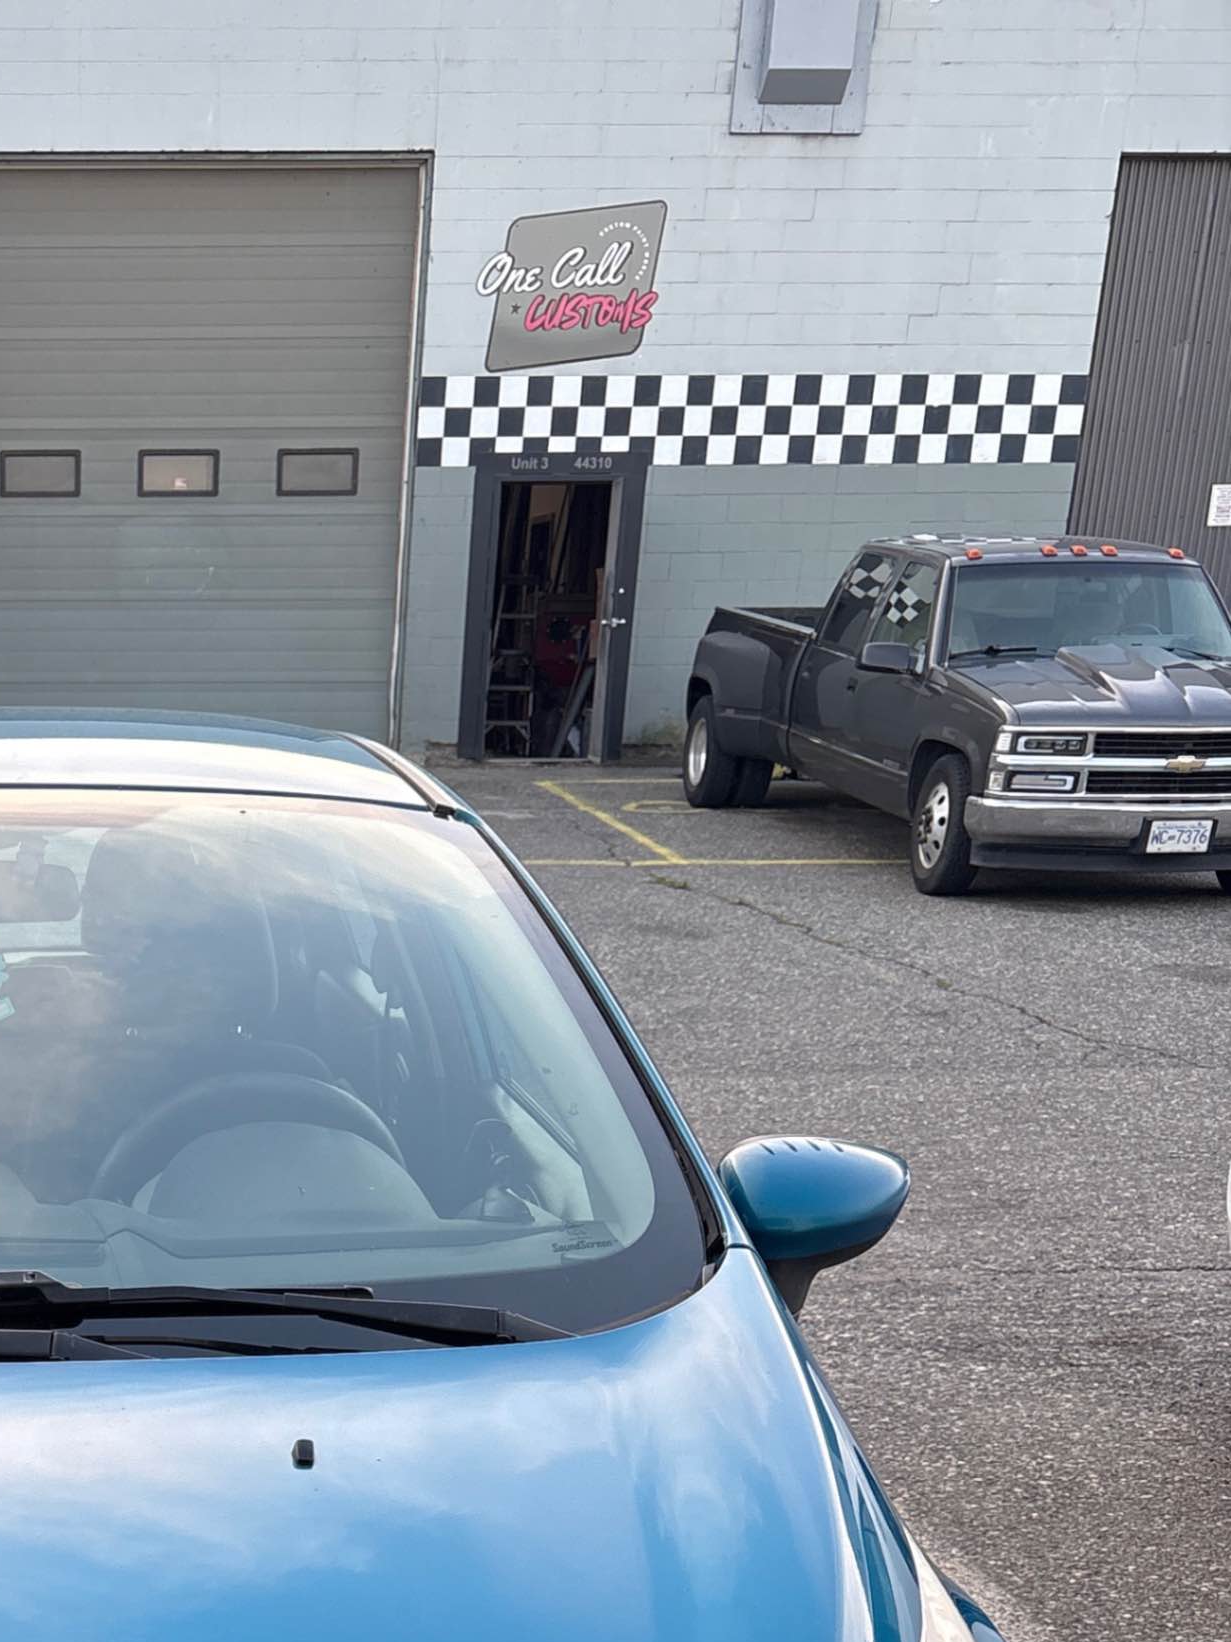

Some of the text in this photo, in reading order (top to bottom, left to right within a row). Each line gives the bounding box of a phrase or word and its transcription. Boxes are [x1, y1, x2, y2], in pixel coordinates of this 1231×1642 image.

[477, 241, 633, 296] One Call
[511, 457, 612, 470] Unit 3 44310
[1176, 829, 1209, 845] 7376
